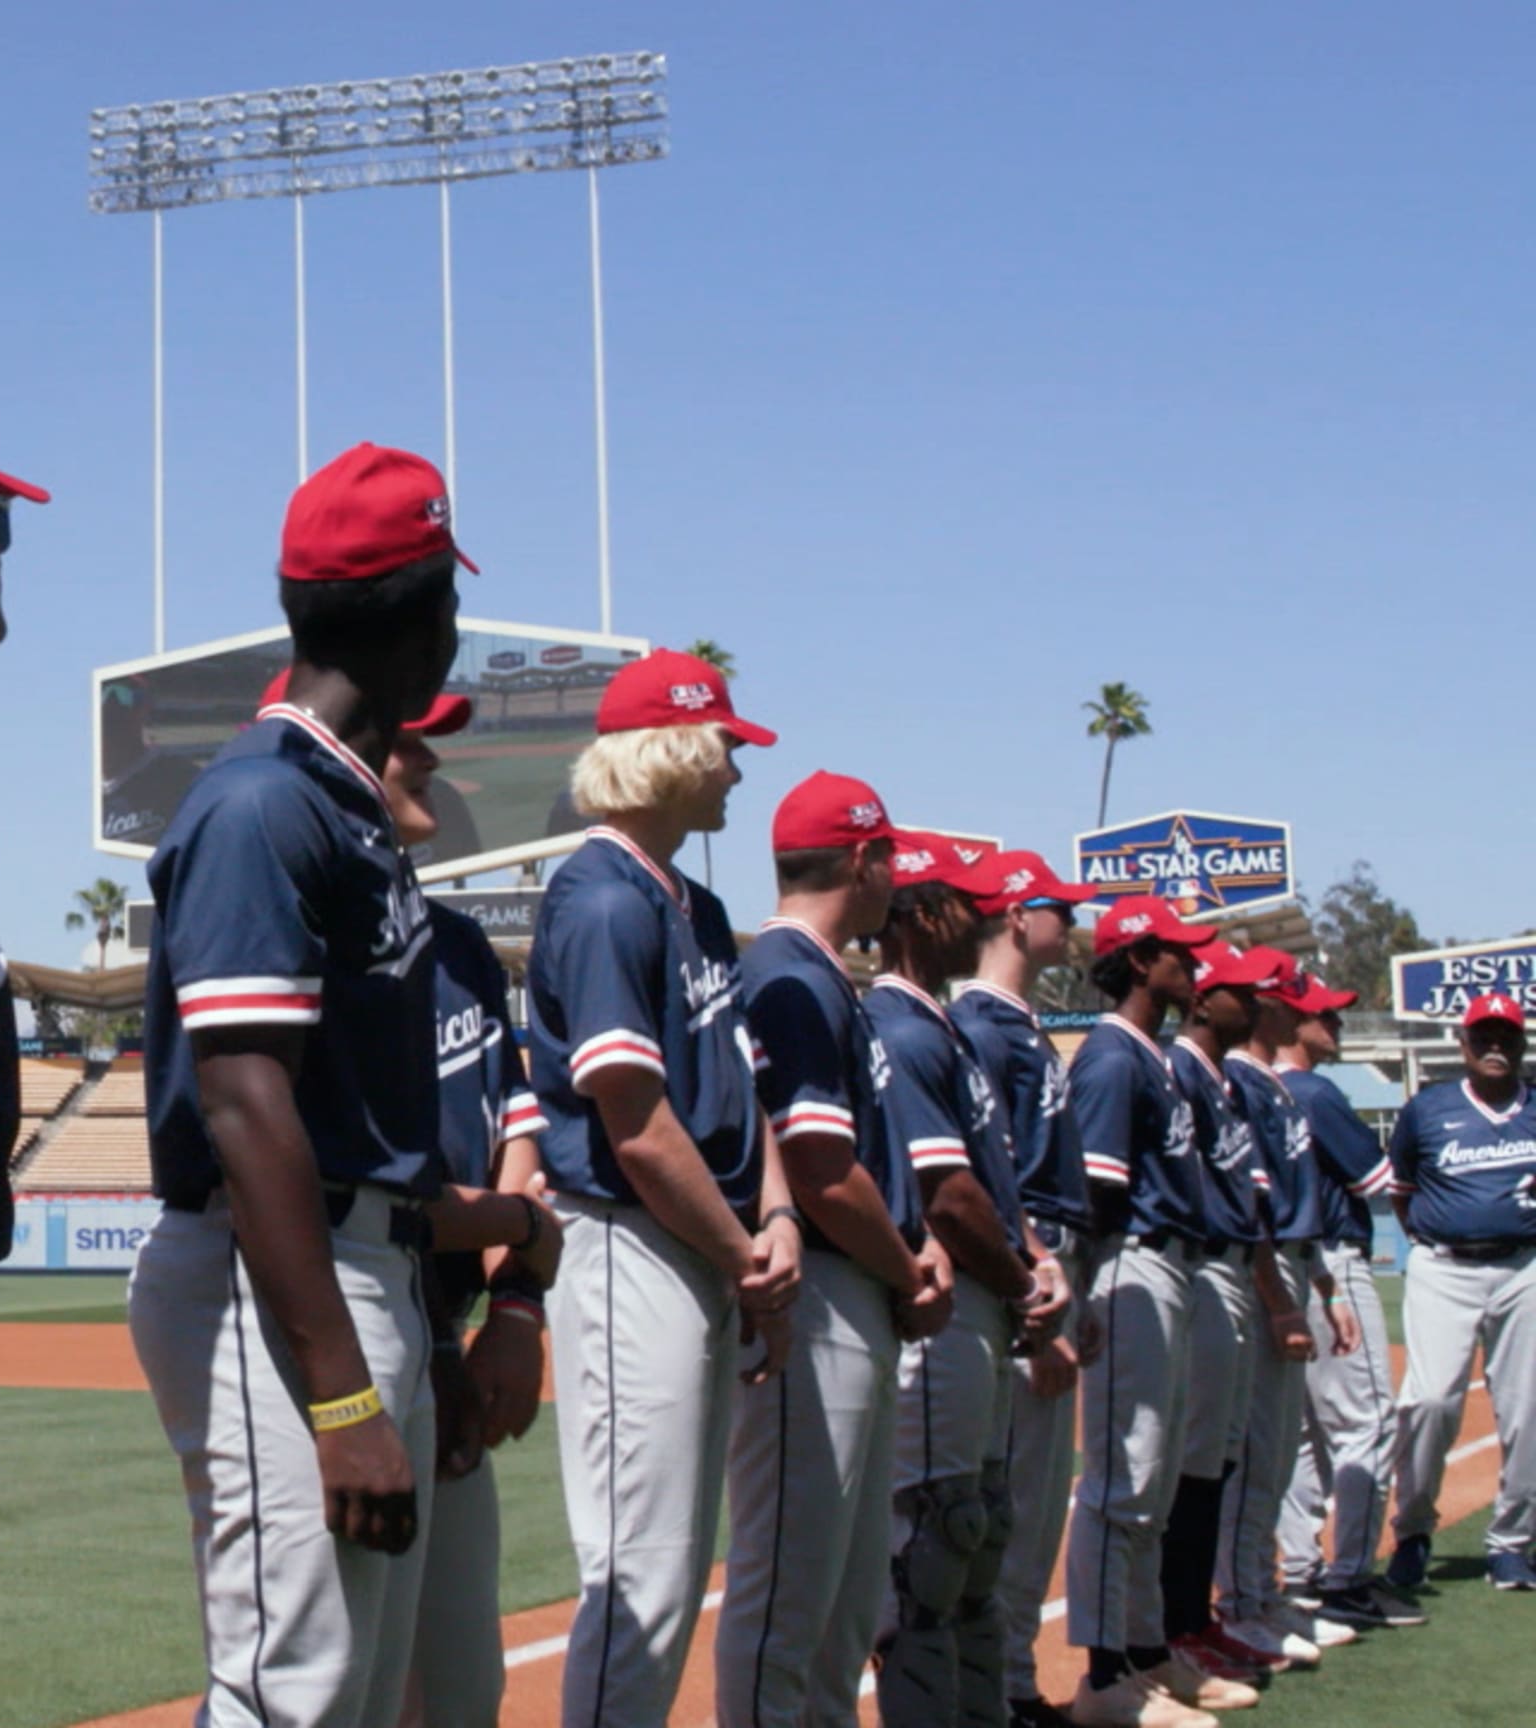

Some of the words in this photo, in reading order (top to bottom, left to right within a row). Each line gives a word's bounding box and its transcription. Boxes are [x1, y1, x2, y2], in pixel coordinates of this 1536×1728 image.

[1137, 853, 1200, 879] STAR
[1203, 847, 1283, 875] GAME
[469, 904, 532, 926] GAME
[1435, 1138, 1536, 1168] American
